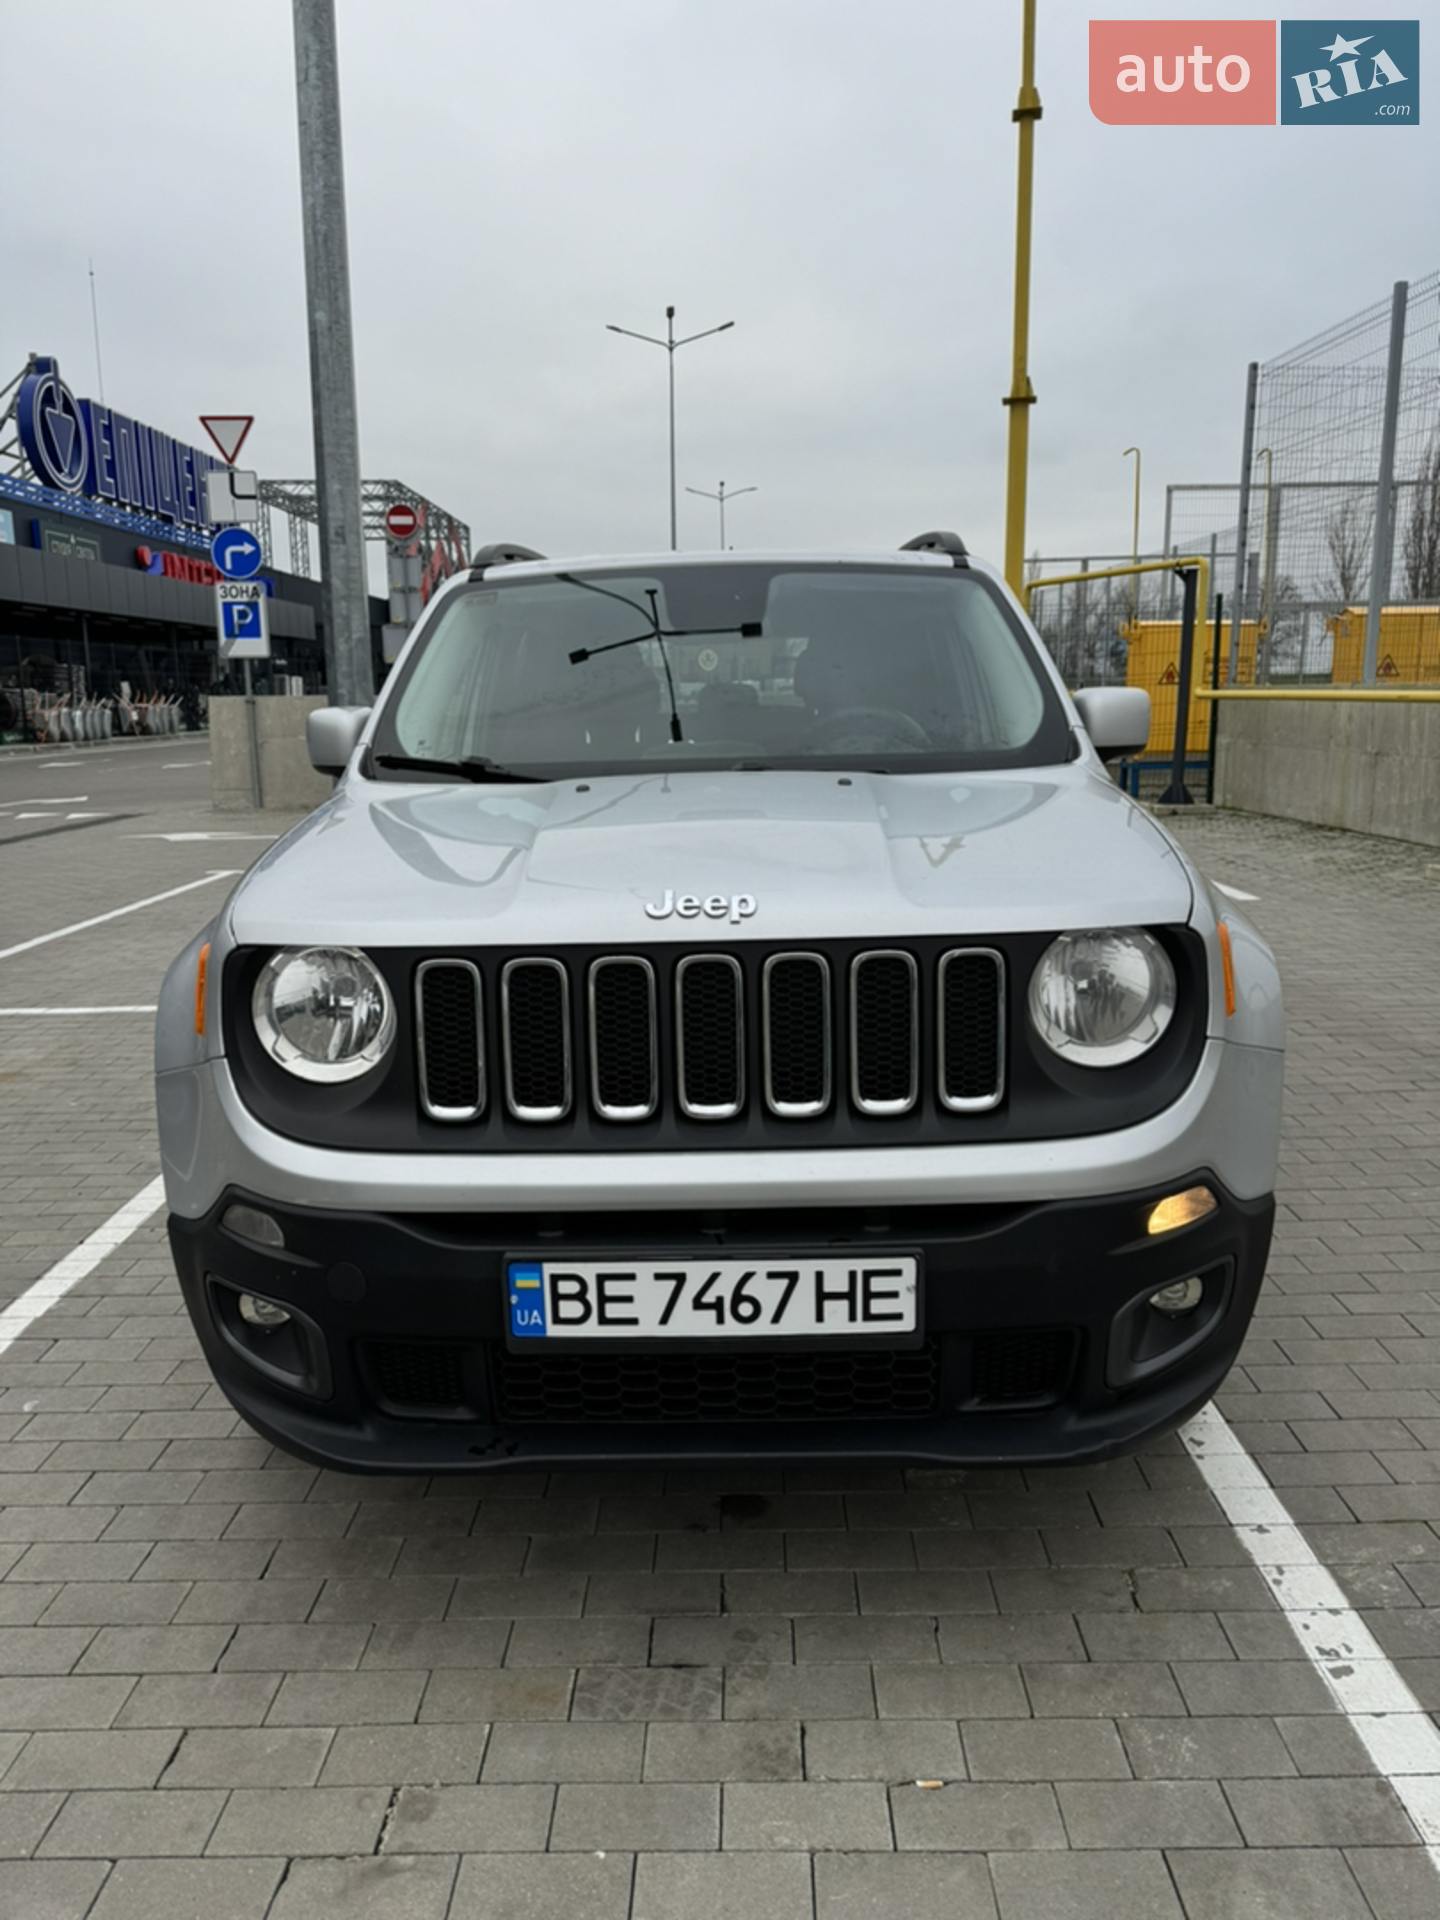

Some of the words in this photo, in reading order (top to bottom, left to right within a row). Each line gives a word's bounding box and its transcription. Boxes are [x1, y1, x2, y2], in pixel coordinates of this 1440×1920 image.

[219, 584, 261, 599] ЗОНА
[232, 604, 253, 635] P
[644, 889, 758, 924] Jeep
[549, 1272, 640, 1326] BE
[653, 1271, 800, 1325] 7467
[814, 1268, 904, 1324] HE
[516, 1309, 543, 1326] UA
